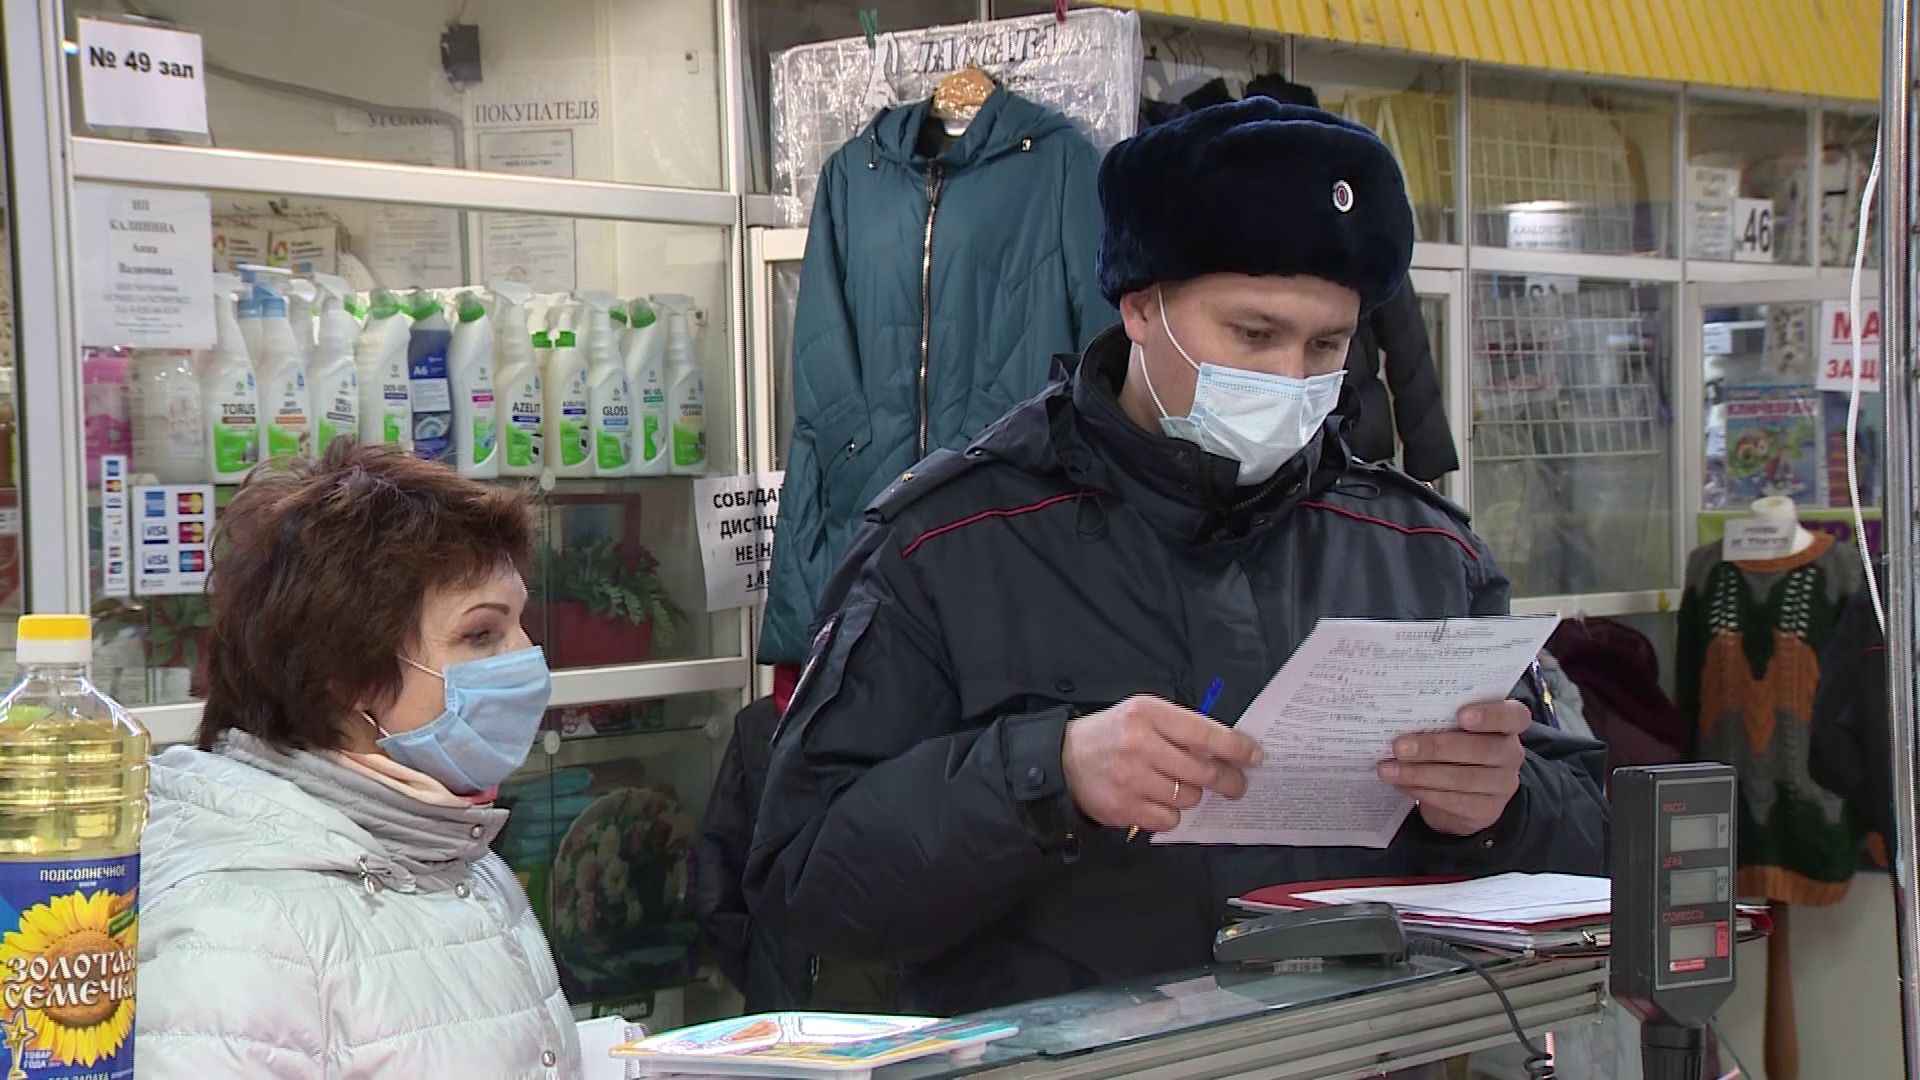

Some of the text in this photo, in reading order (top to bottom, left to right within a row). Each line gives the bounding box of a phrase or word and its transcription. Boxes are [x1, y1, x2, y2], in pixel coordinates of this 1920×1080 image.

[125, 50, 151, 73] 49
[158, 61, 194, 80] зал
[475, 100, 598, 124] ПОКУПАТЕЛЯ
[1743, 207, 1770, 254] 46
[221, 403, 256, 415] TORUS
[512, 401, 541, 414] AZELIT
[602, 405, 629, 417] GLOSS
[40, 864, 127, 882] ПОДСОЛНЕЧНОЕ
[4, 945, 136, 983] ЗОЛОТАЯ
